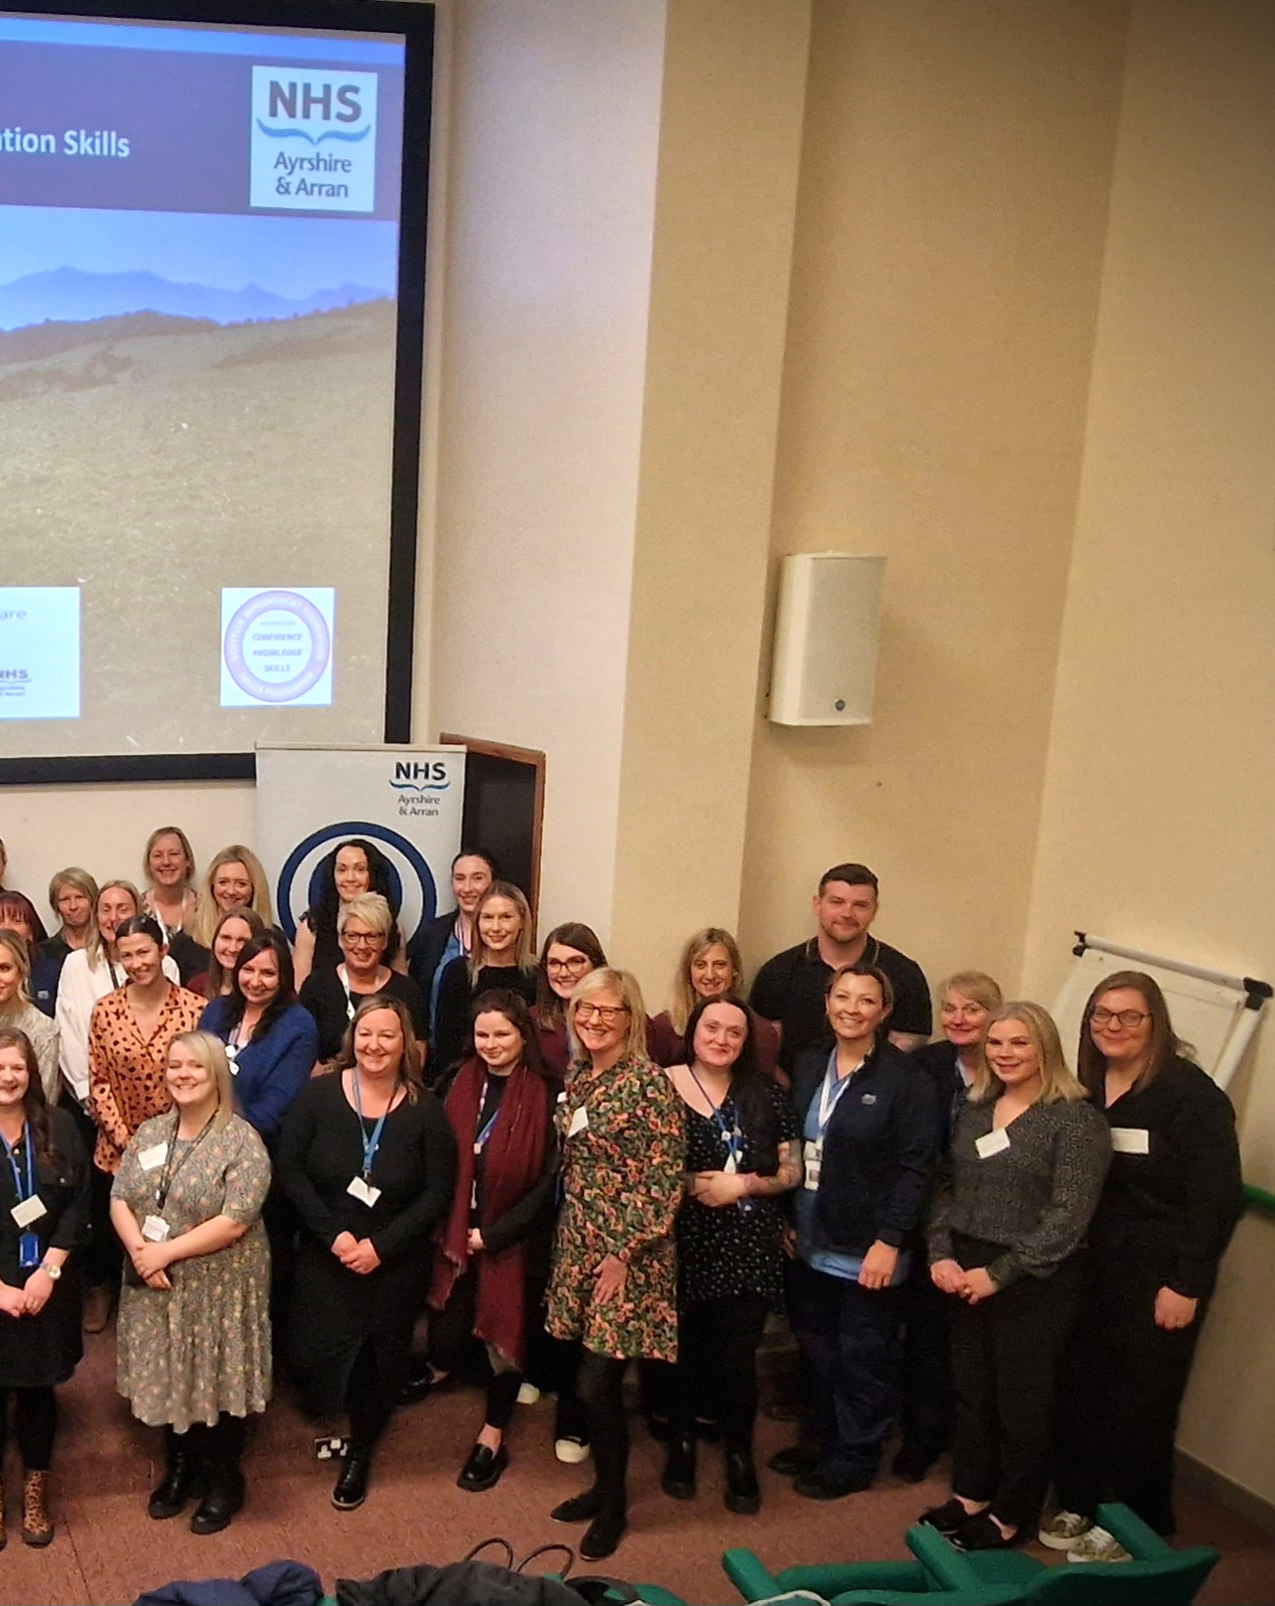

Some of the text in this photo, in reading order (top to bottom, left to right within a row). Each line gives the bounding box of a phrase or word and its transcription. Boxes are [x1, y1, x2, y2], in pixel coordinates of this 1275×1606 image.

[268, 79, 362, 123] NHS
[63, 129, 130, 158] Skills
[273, 150, 353, 176] Ayrshire
[275, 176, 349, 198] & Arran
[394, 761, 447, 781] NHS
[397, 794, 441, 806] Ayrshire
[398, 806, 440, 817] & Arran
